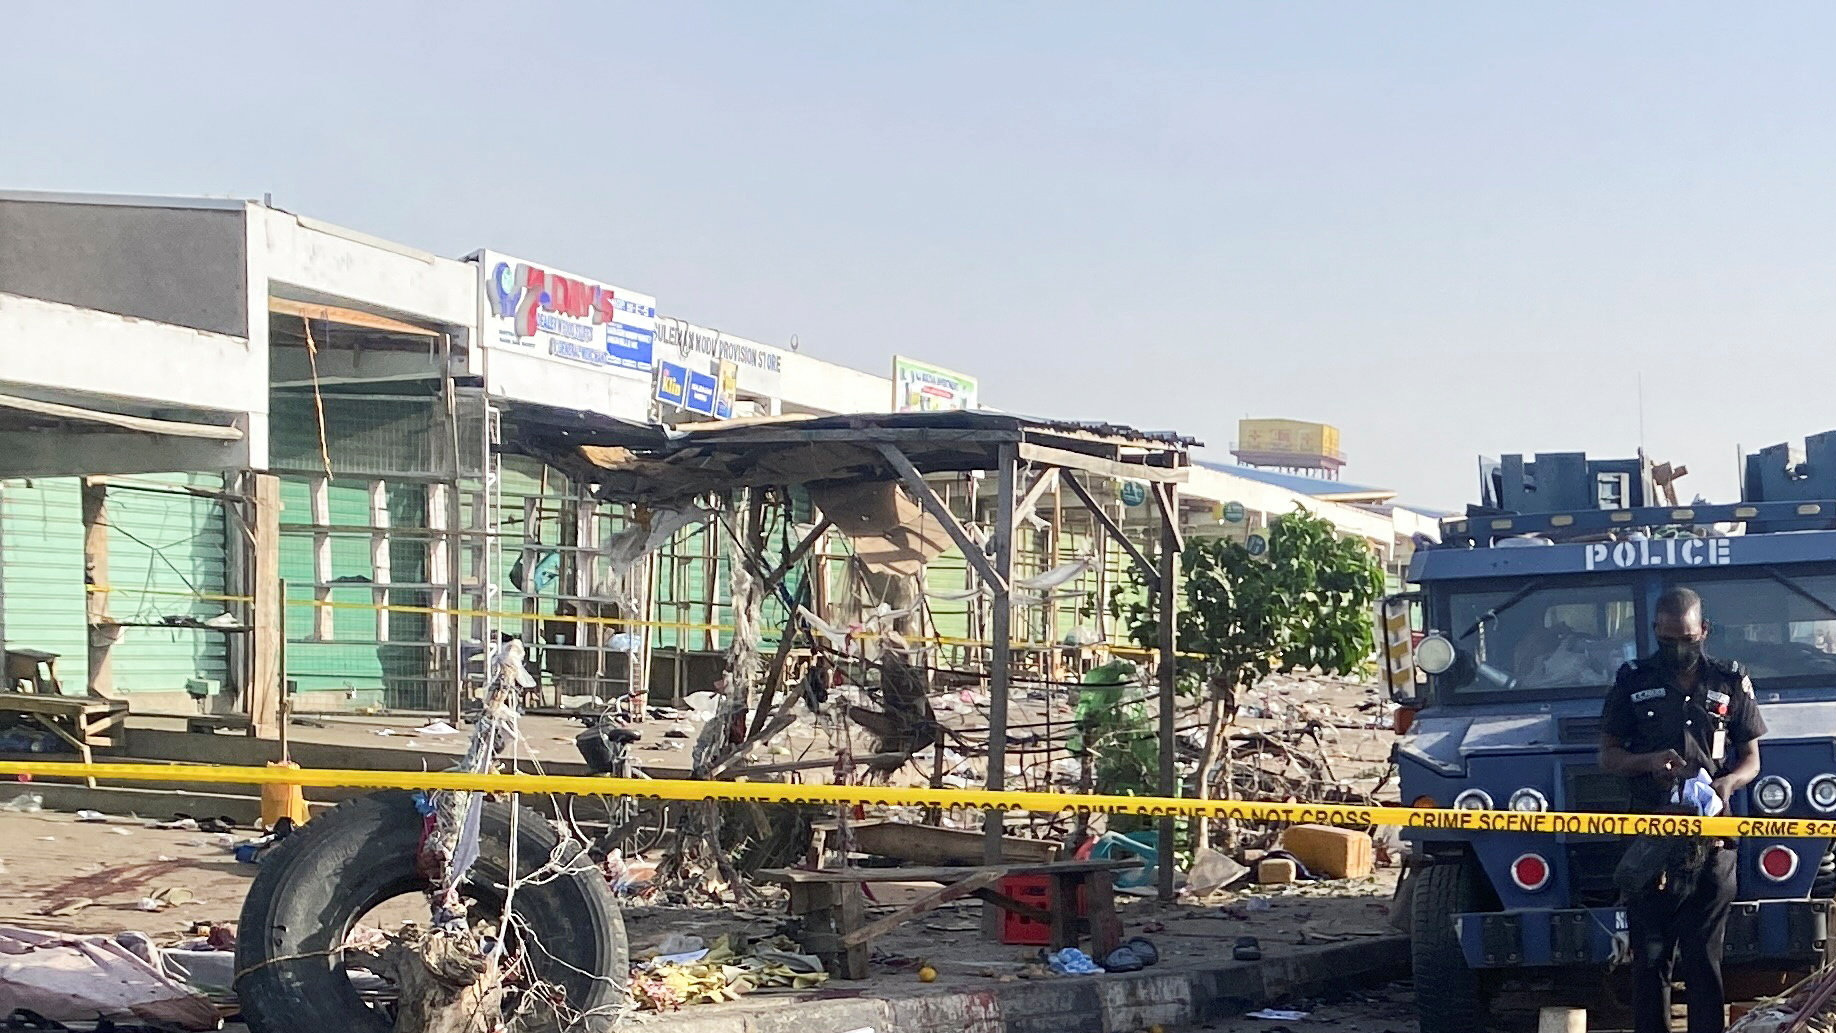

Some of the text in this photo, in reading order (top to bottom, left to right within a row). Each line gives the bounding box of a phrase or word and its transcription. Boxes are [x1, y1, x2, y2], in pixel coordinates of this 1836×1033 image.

[719, 340, 757, 366] PROVISION
[758, 350, 782, 373] STORE
[1585, 538, 1730, 570] POLICE
[1252, 808, 1293, 821] NOT
[1301, 810, 1371, 825] CROSS
[1409, 812, 1702, 835] CRIME SCENE DO NOT CROSS
[1737, 820, 1799, 836] CRIME
